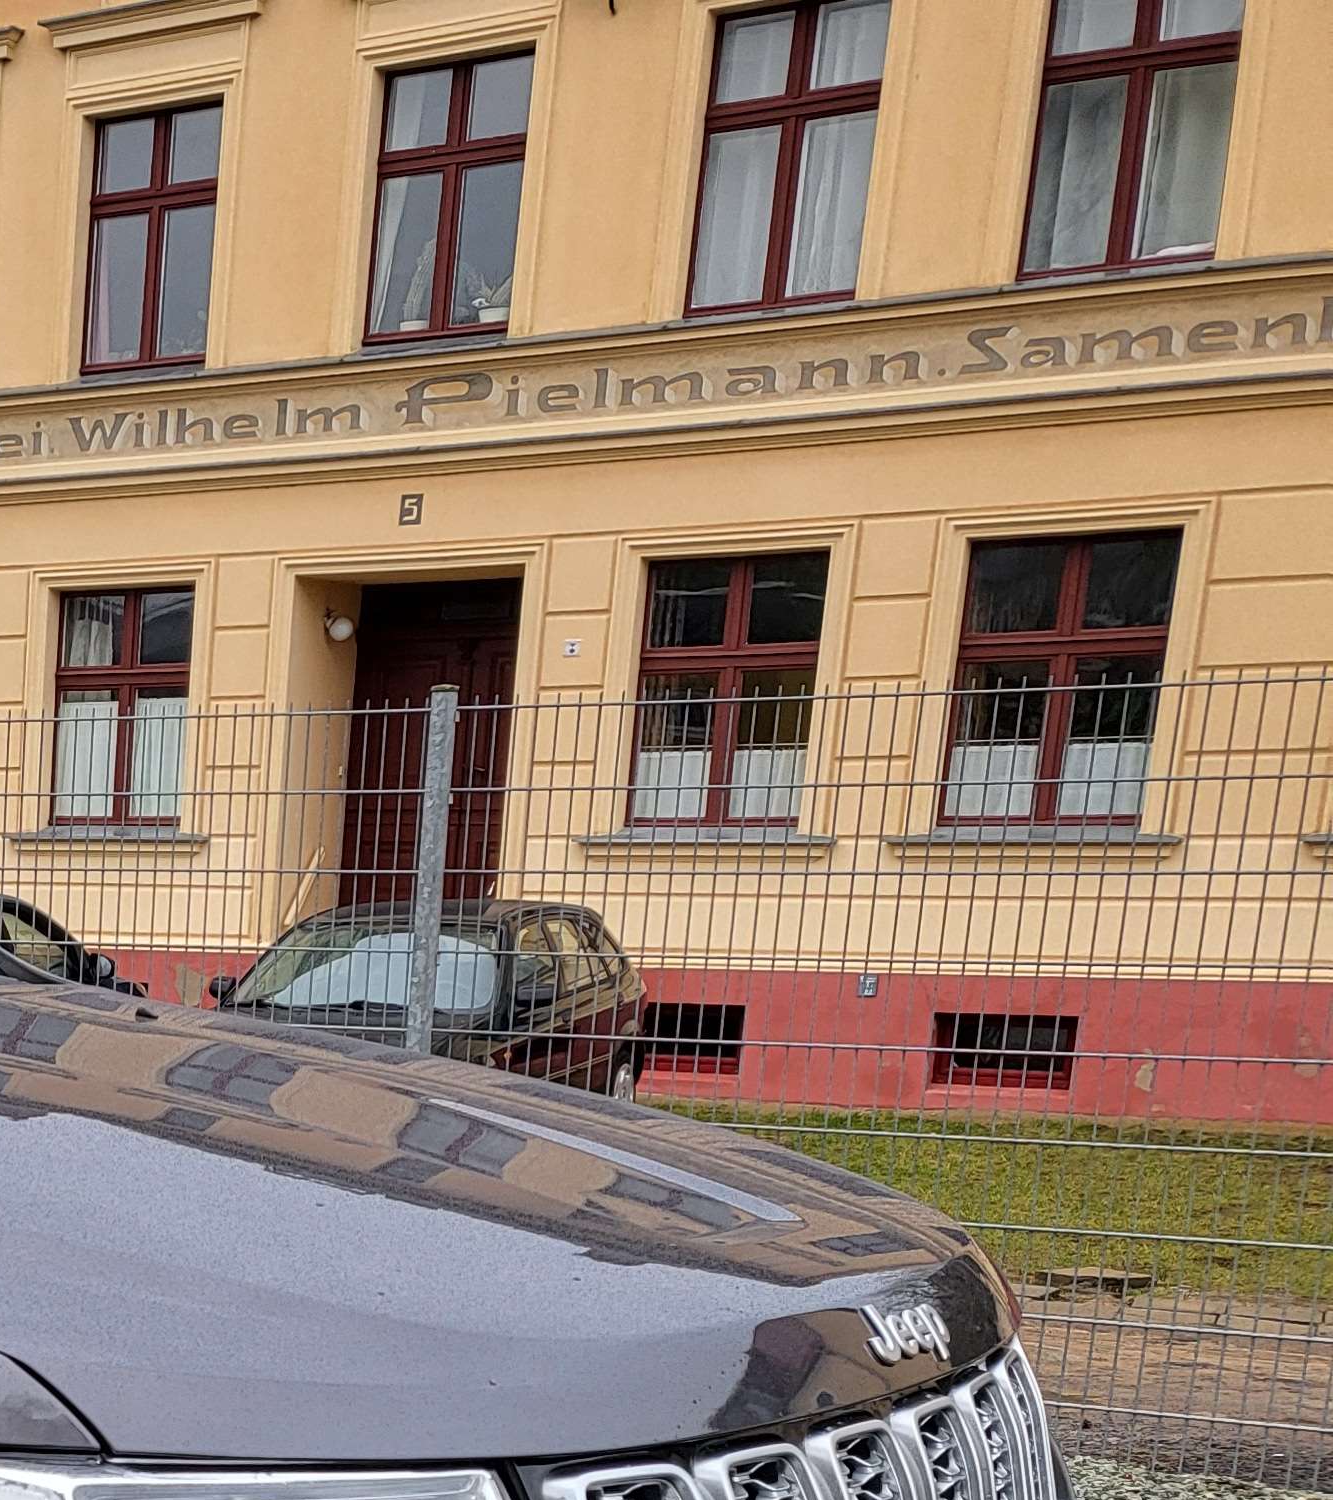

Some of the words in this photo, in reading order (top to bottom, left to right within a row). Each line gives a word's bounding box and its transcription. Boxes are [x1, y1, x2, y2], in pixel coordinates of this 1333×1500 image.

[67, 397, 362, 455] Wilhelm
[402, 498, 418, 521] 5
[858, 1303, 951, 1366] Jeep
